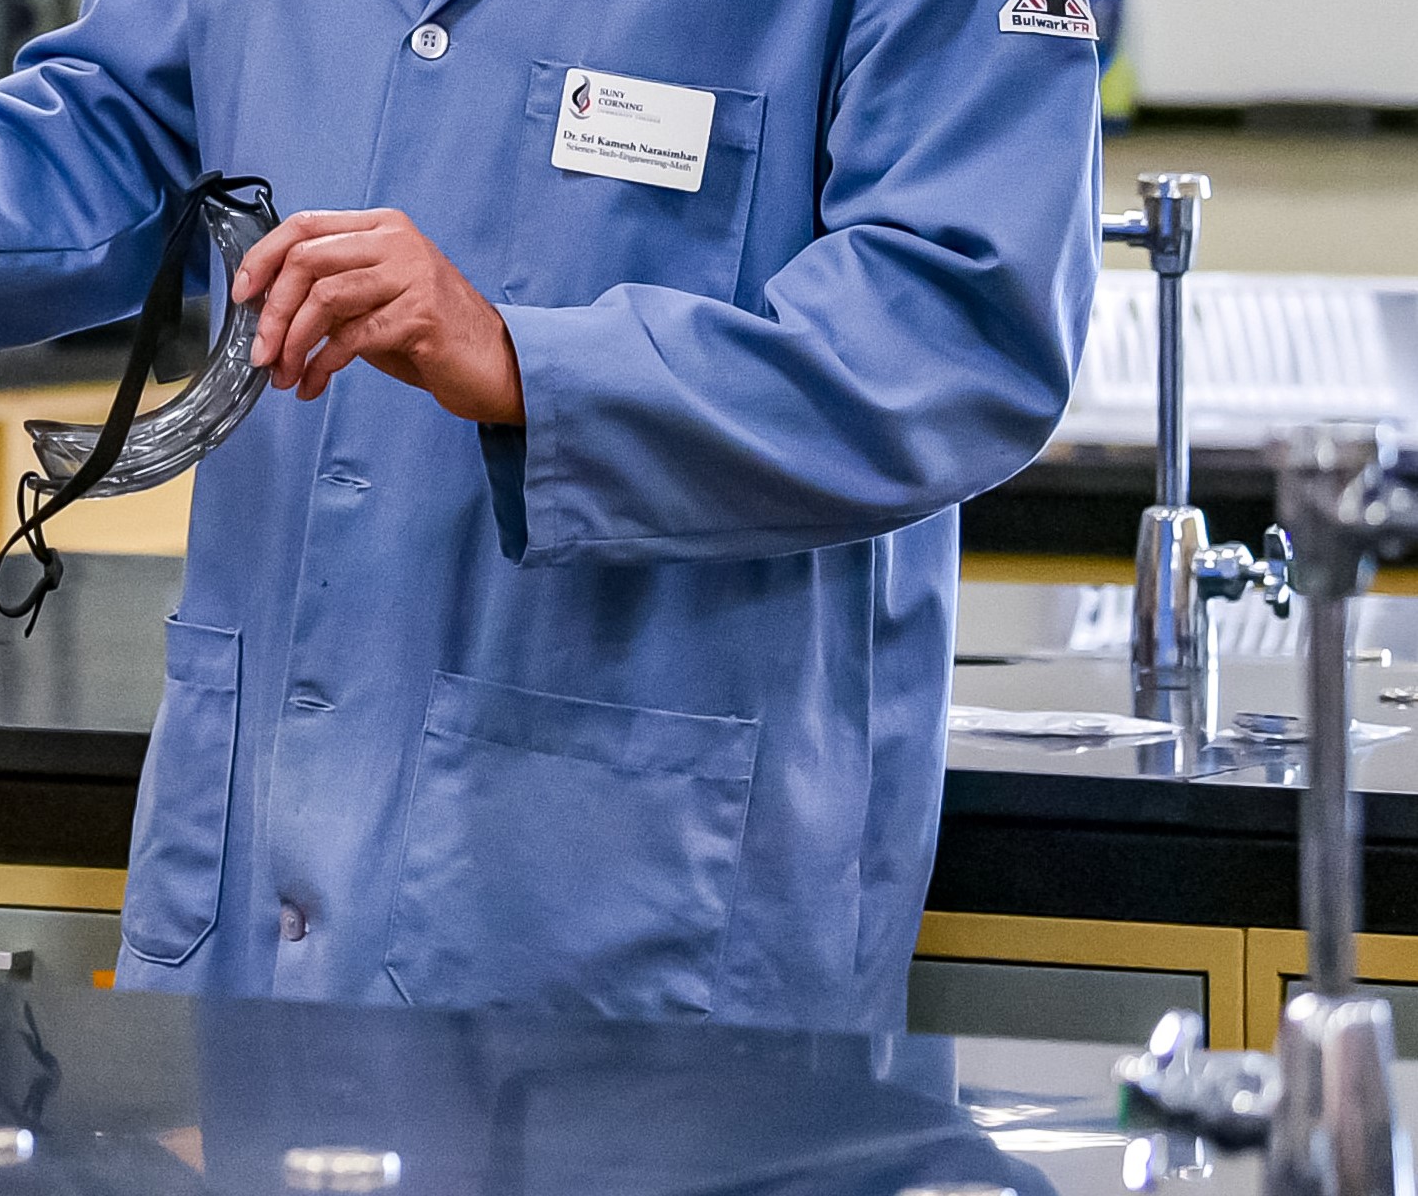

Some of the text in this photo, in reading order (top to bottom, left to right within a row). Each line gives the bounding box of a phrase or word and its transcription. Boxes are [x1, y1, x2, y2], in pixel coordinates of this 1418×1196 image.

[1012, 15, 1089, 33] Bulwark FR
[599, 87, 626, 99] SUNY
[598, 98, 643, 112] CORNING
[563, 130, 699, 162] Dr. Sri Kamesh Narasimhan
